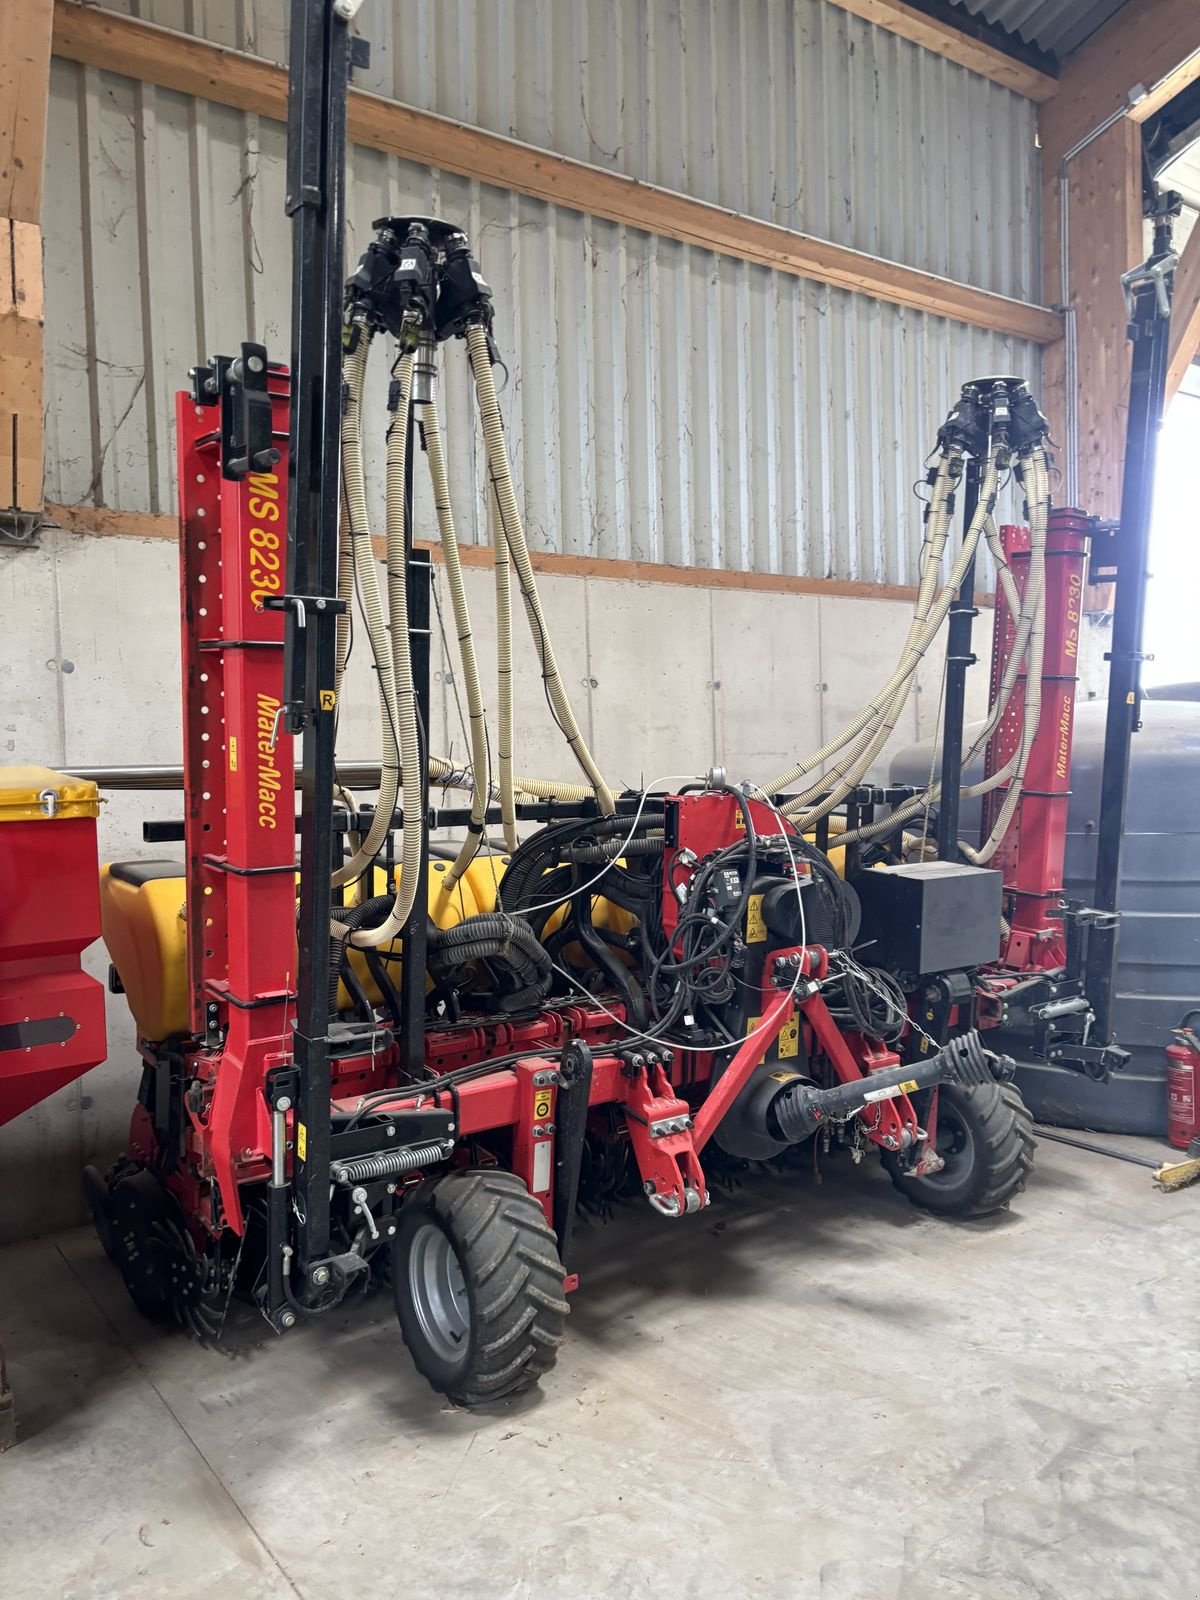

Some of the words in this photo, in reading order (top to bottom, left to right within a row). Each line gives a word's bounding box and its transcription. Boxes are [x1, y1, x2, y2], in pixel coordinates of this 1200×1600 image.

[248, 472, 280, 521] MS
[322, 694, 333, 706] R
[257, 693, 281, 829] MaterMacc
[1056, 695, 1071, 778] MaterMacc
